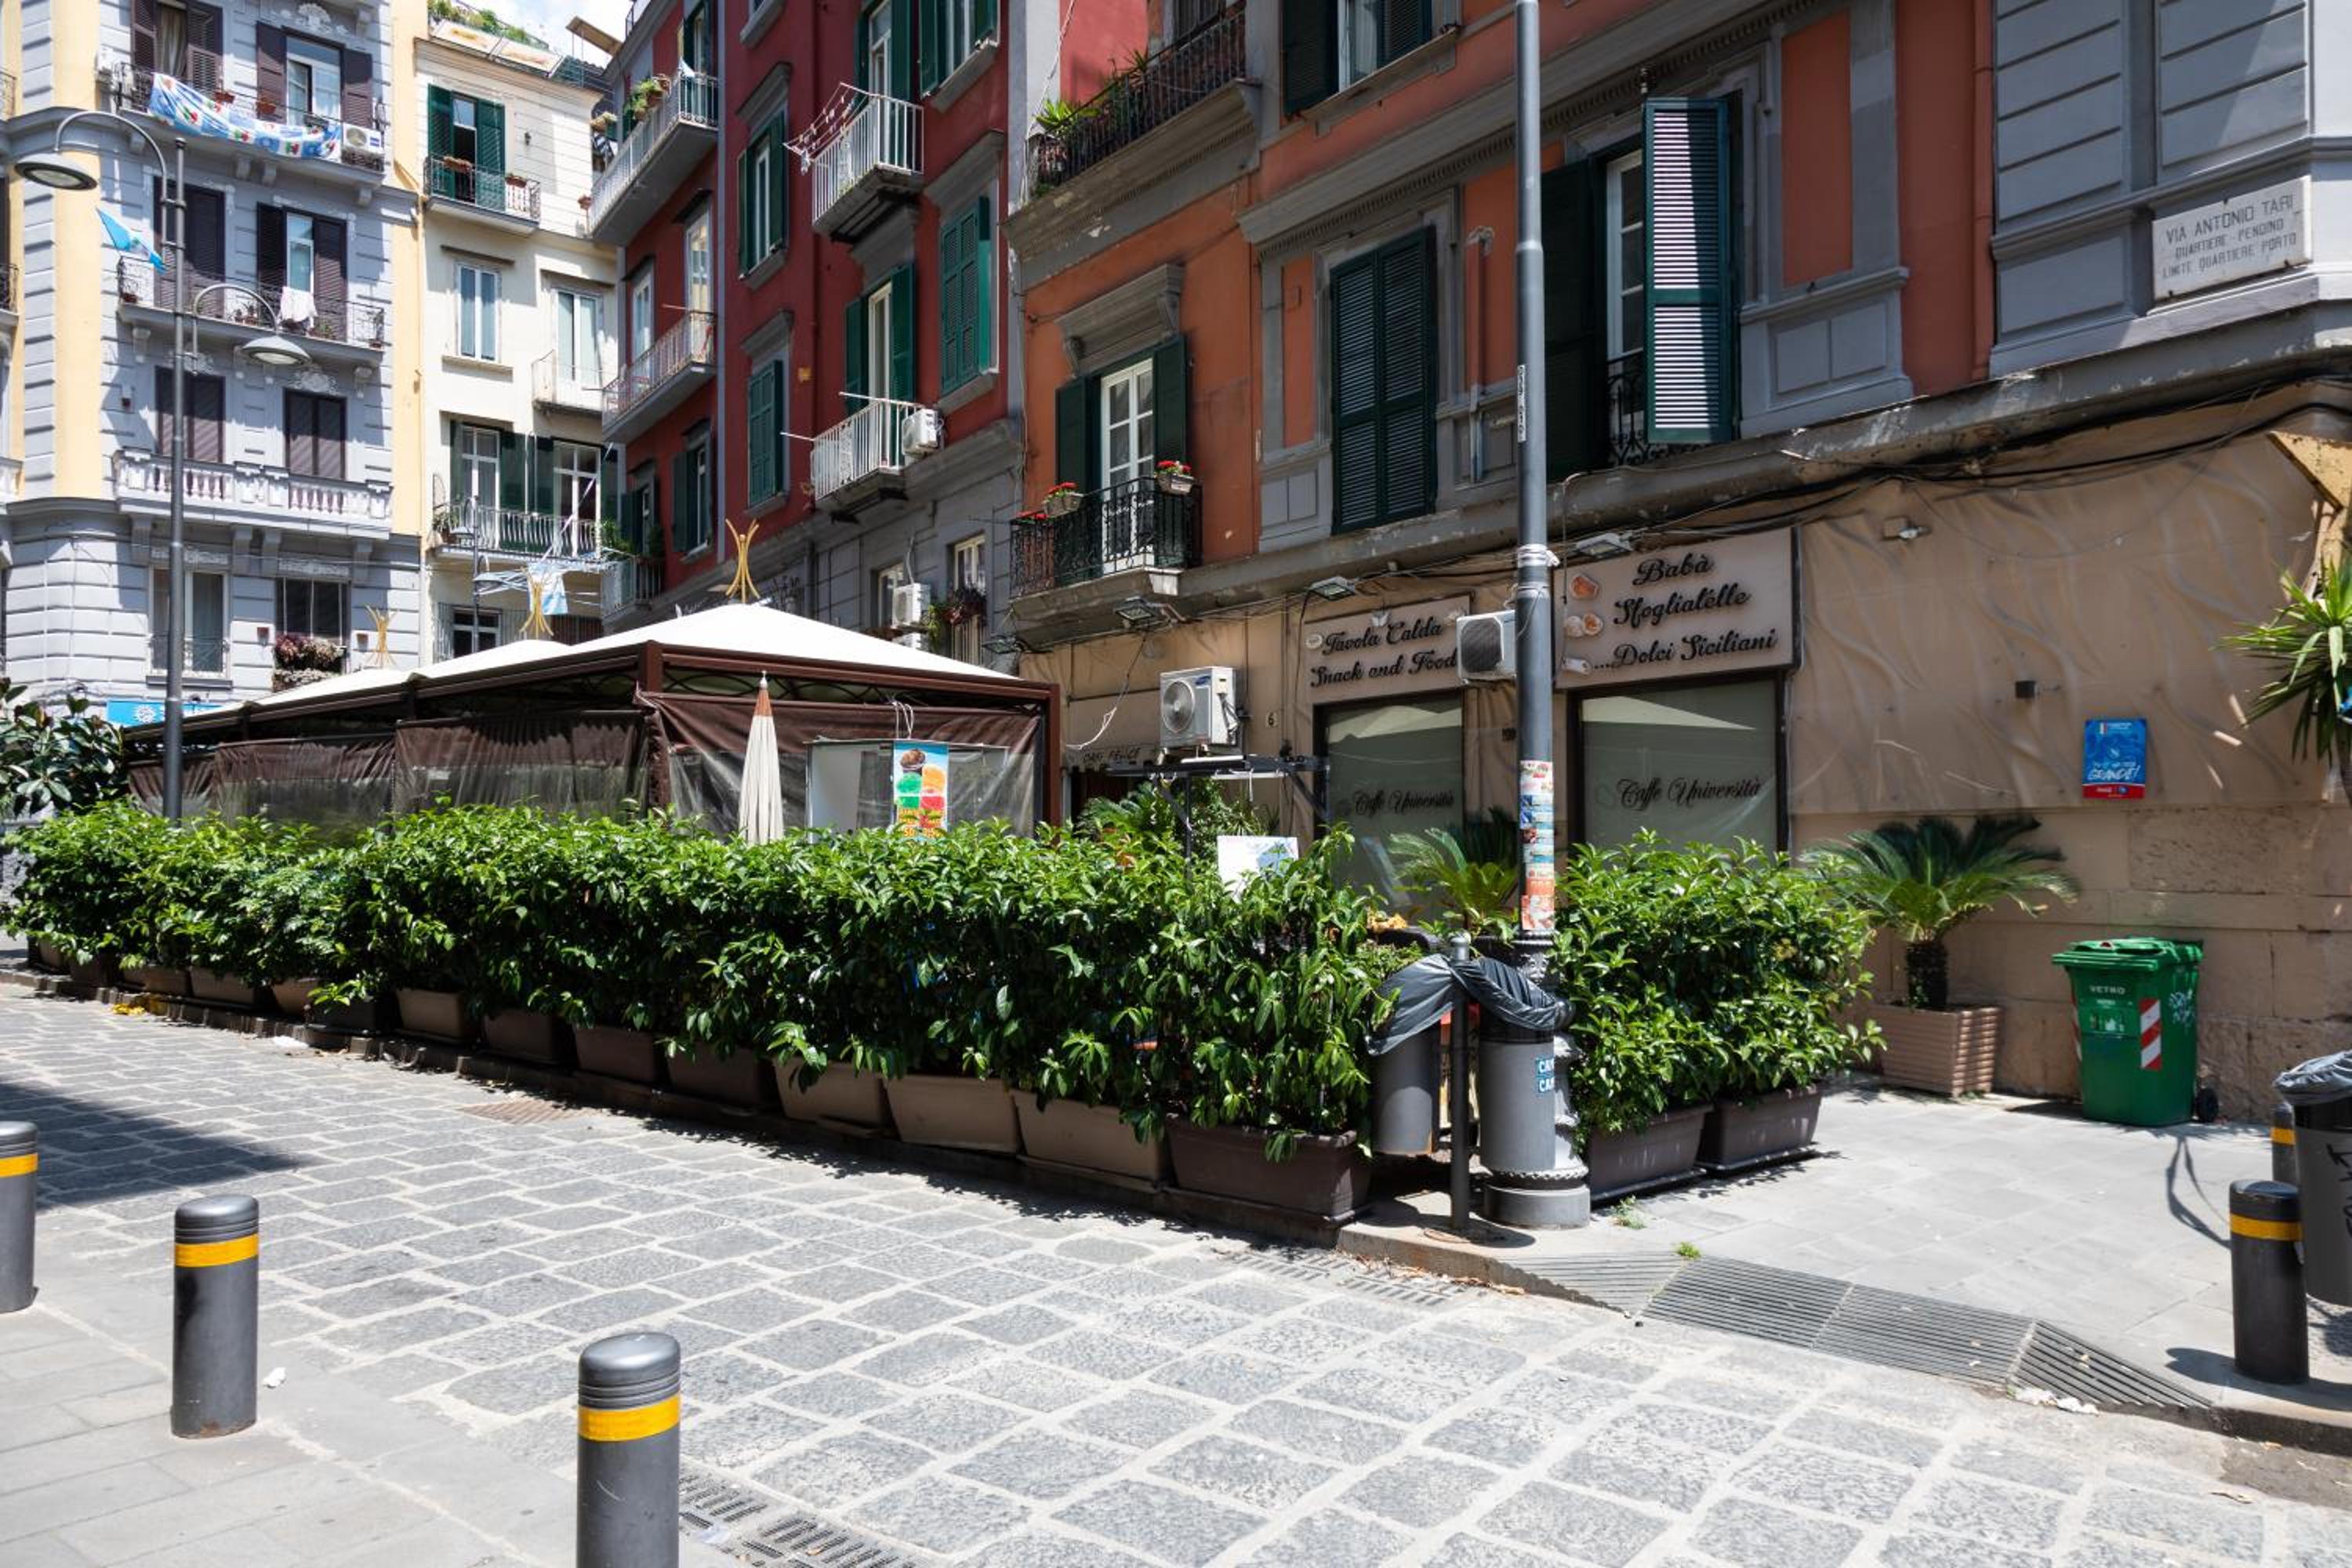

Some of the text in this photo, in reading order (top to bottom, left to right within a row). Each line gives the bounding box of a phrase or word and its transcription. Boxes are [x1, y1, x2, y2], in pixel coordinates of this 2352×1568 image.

[2166, 194, 2294, 245] VIA ANTONIO TARI
[2176, 218, 2284, 260] QUARTIERE PENDINO
[2163, 233, 2296, 278] LIMITE QUARTIERE PORTO
[1613, 583, 1752, 628] Sfogliatelle
[1322, 616, 1443, 655] Tavola Calda
[1680, 628, 1778, 660] Siciliani
[1310, 648, 1457, 688] Snack and Food
